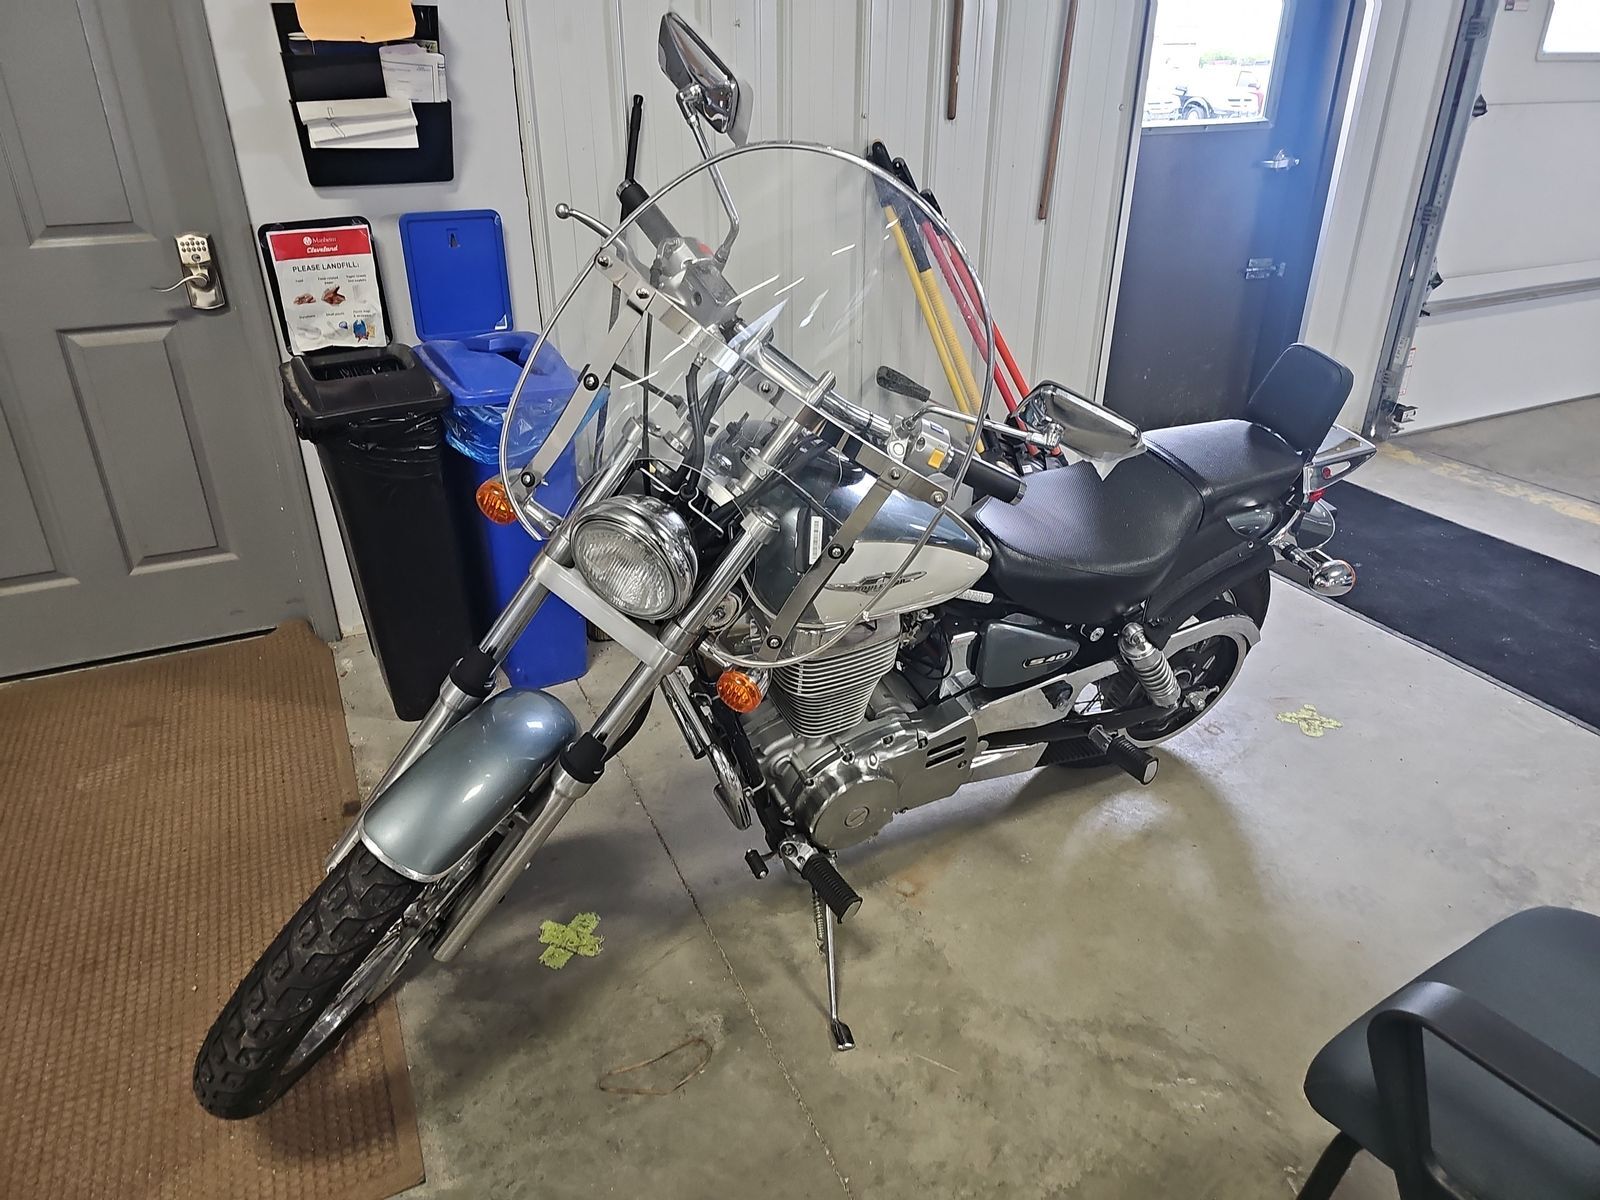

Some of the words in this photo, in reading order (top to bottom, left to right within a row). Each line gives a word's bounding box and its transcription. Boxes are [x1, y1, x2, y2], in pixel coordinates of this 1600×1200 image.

[306, 245, 338, 253] Cleveland
[292, 264, 320, 272] PLEASE
[1029, 652, 1068, 665] S40
